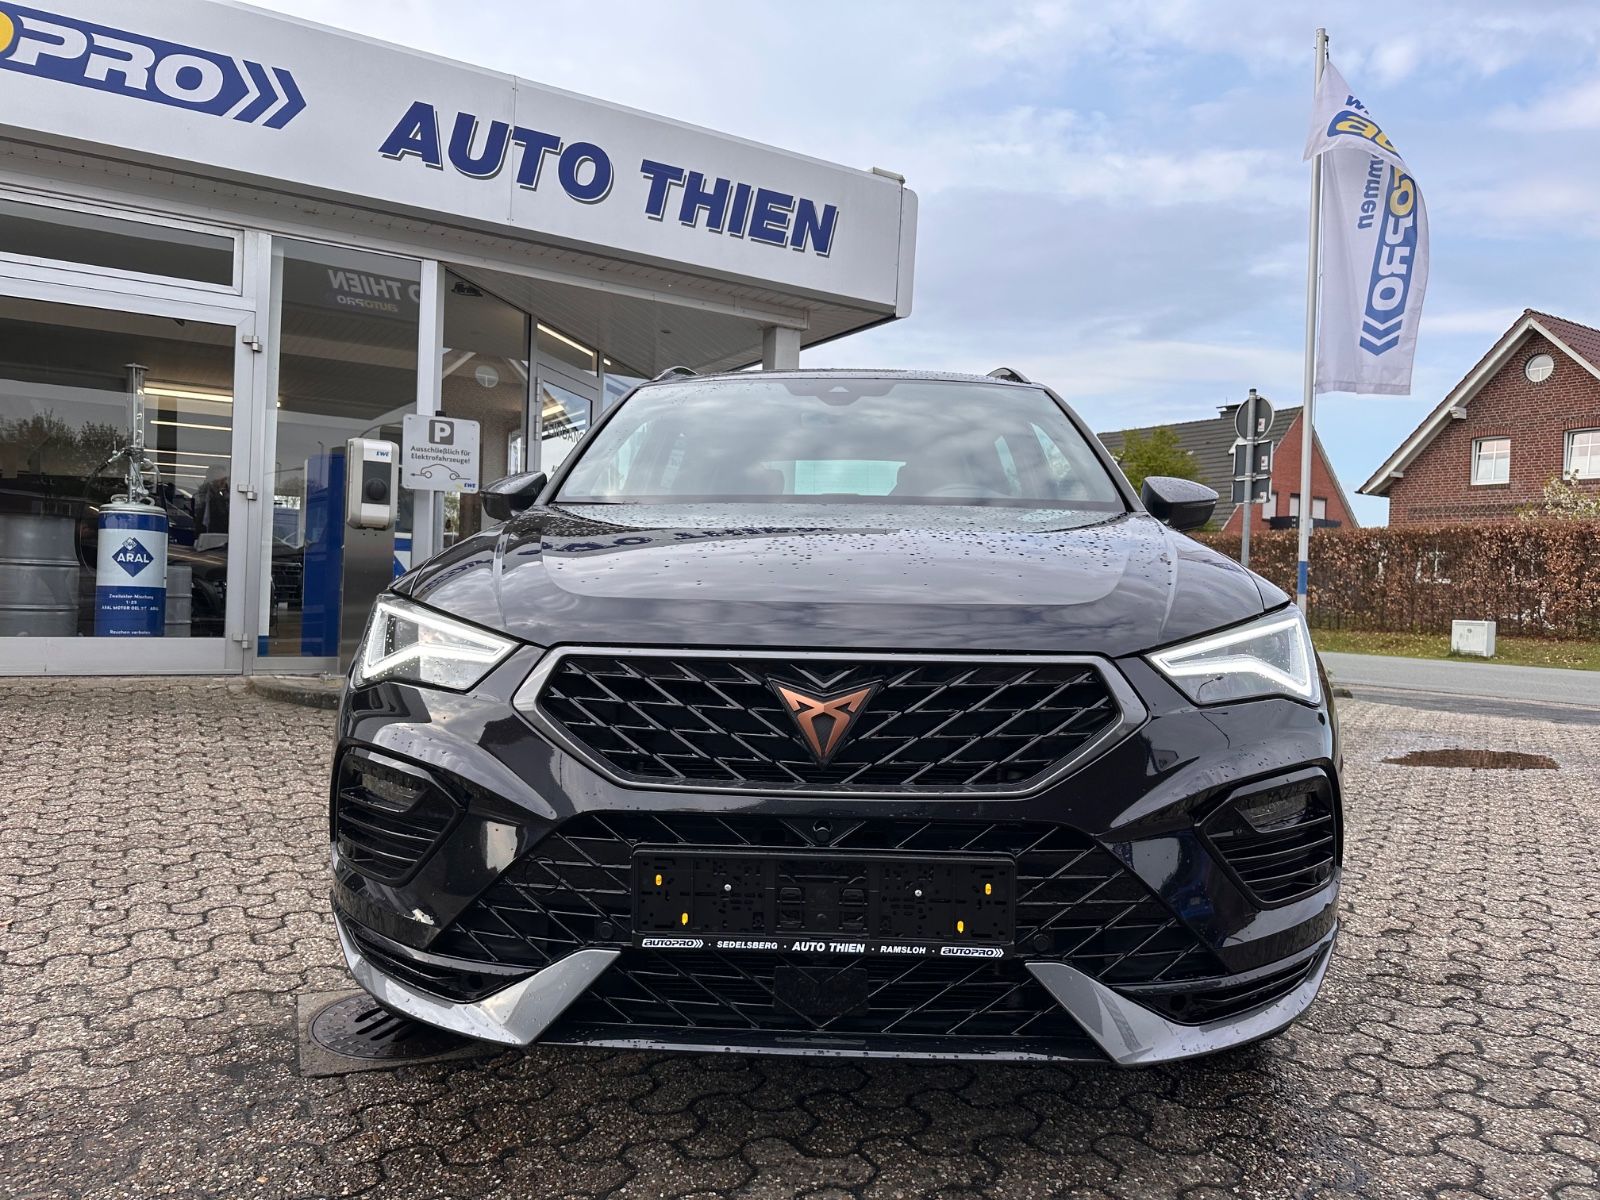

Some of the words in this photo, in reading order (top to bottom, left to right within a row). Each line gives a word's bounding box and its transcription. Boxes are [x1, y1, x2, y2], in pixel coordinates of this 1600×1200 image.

[0, 10, 224, 103] PRO
[379, 101, 614, 204] AUTO
[641, 158, 839, 256] THIEN
[434, 422, 451, 443] P
[410, 445, 460, 456] Ausschließlich
[460, 449, 471, 457] für
[411, 453, 471, 465] Elektrofahrzeuge!
[117, 552, 149, 563] ARAL
[716, 940, 778, 950] SEDELSBERG
[791, 941, 826, 952] AUTO
[829, 942, 865, 953] THIEN
[880, 945, 927, 954] RAMSLOH
